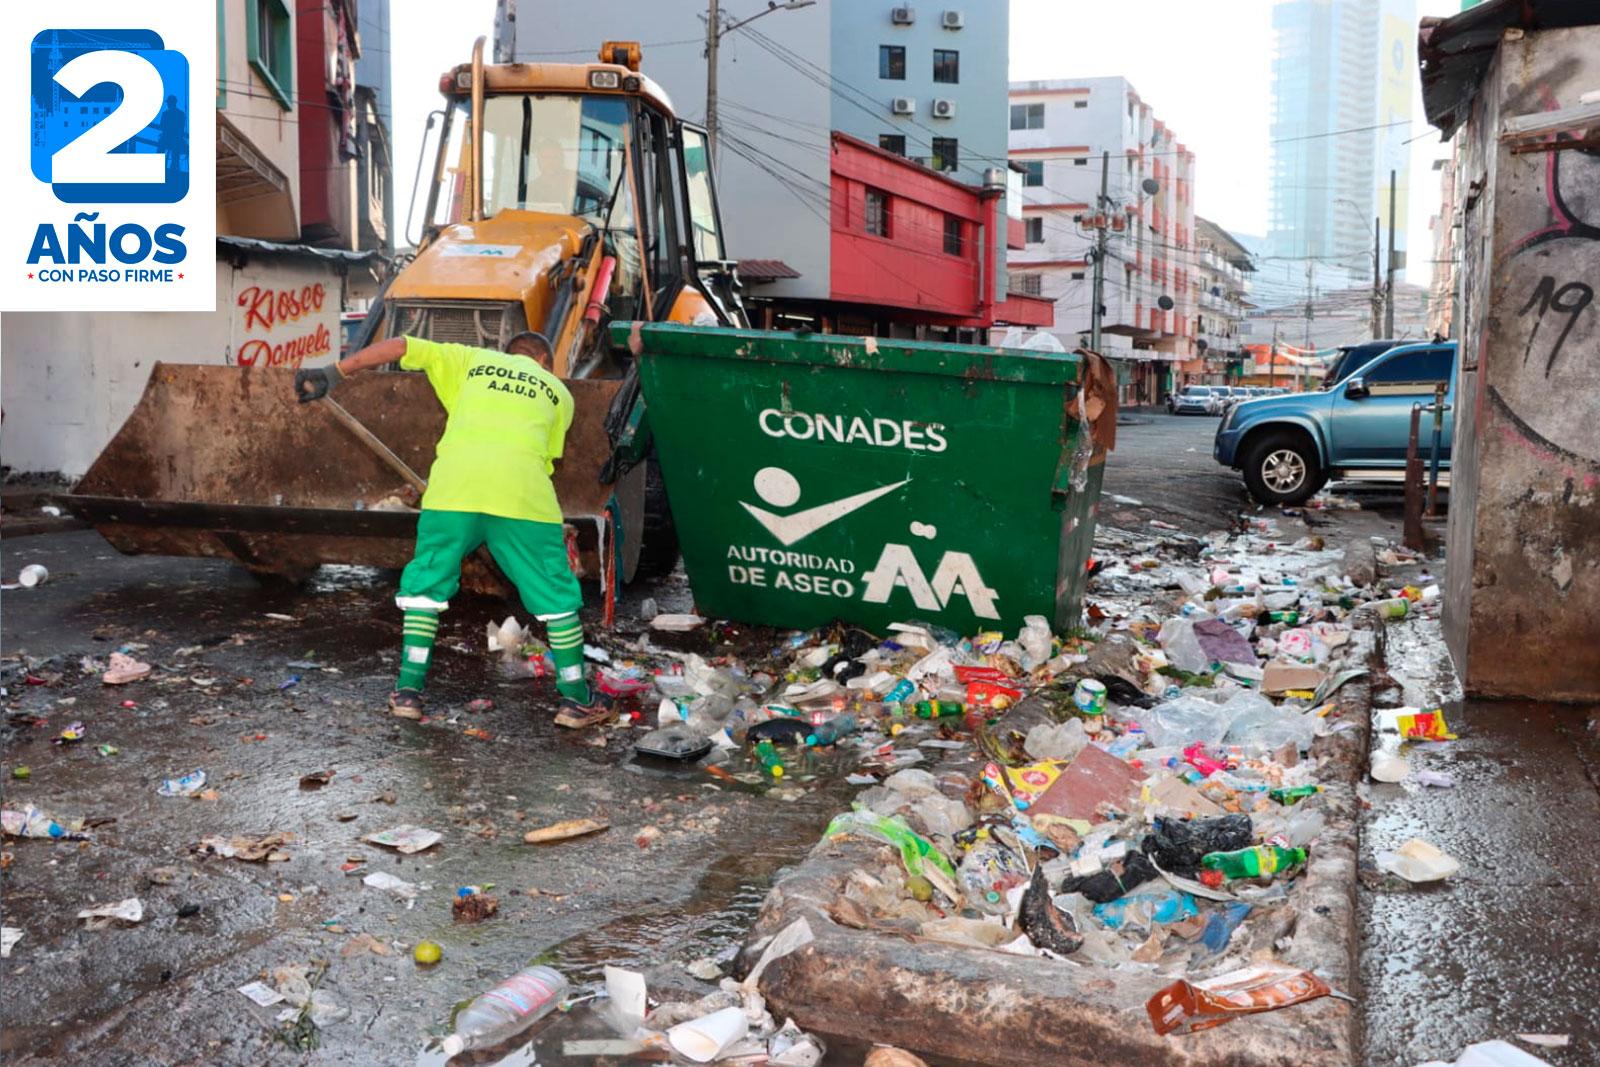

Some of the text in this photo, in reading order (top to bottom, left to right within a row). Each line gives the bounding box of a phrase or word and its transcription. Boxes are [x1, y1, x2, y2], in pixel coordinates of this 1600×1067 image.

[1515, 276, 1594, 379] 19
[467, 365, 560, 406] RECOLECTOR
[759, 408, 947, 452] CONADES
[727, 545, 855, 574] AUTORIDAD
[728, 565, 855, 598] DE ASEO
